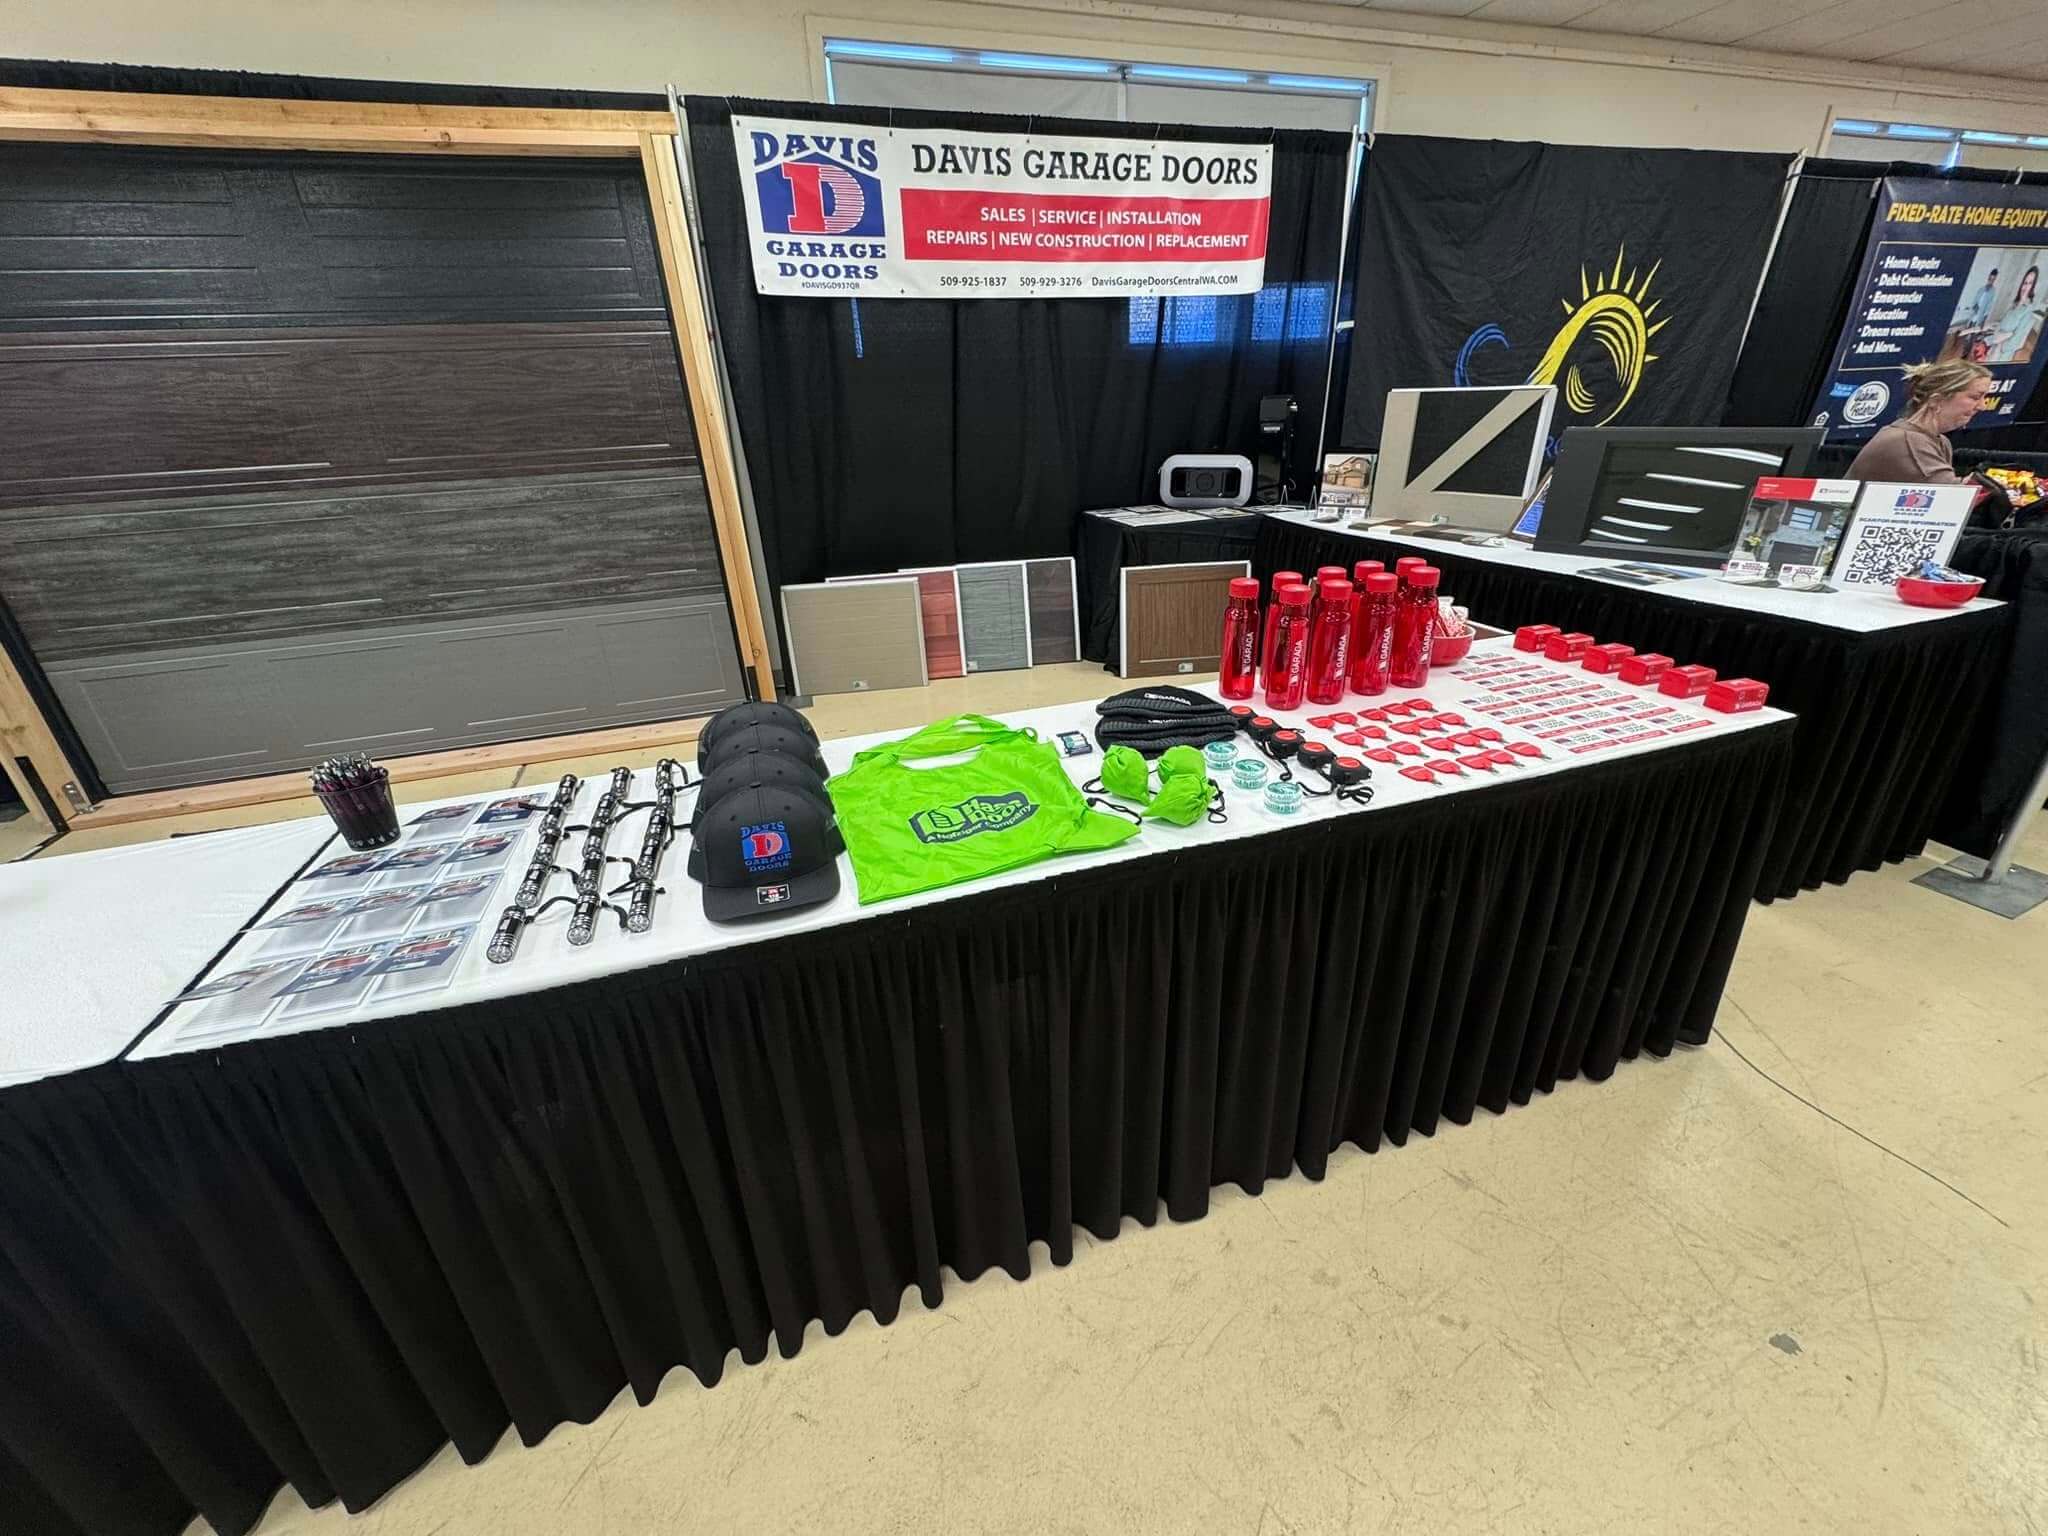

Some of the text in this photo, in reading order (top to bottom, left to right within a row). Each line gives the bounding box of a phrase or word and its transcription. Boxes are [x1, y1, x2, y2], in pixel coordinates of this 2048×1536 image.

[751, 131, 878, 172] DAVIS
[911, 144, 1258, 185] DAVIS GARAGE DOORS
[980, 207, 1201, 226] SALES SERVICE INSTALLATION
[1886, 202, 1964, 225] FIXED-RATE
[1962, 206, 2001, 226] HOME
[2001, 208, 2045, 229] EQUITY
[926, 230, 1249, 248] REPAIRS NEW CONSTRUCTION REPLACEMENT
[766, 240, 887, 259] GARAGE
[778, 262, 879, 280] DOORS
[940, 275, 1238, 288] 509-925-1837 509-929-3276 DavisGarageDoorsCentralWA.COM
[1866, 308, 1909, 321] Education
[1860, 324, 1925, 338] Dream vacation
[1855, 341, 1876, 354] And
[1291, 639, 1303, 674] GARAGA
[740, 821, 785, 838] DAVIS
[745, 853, 793, 866] GARAGE
